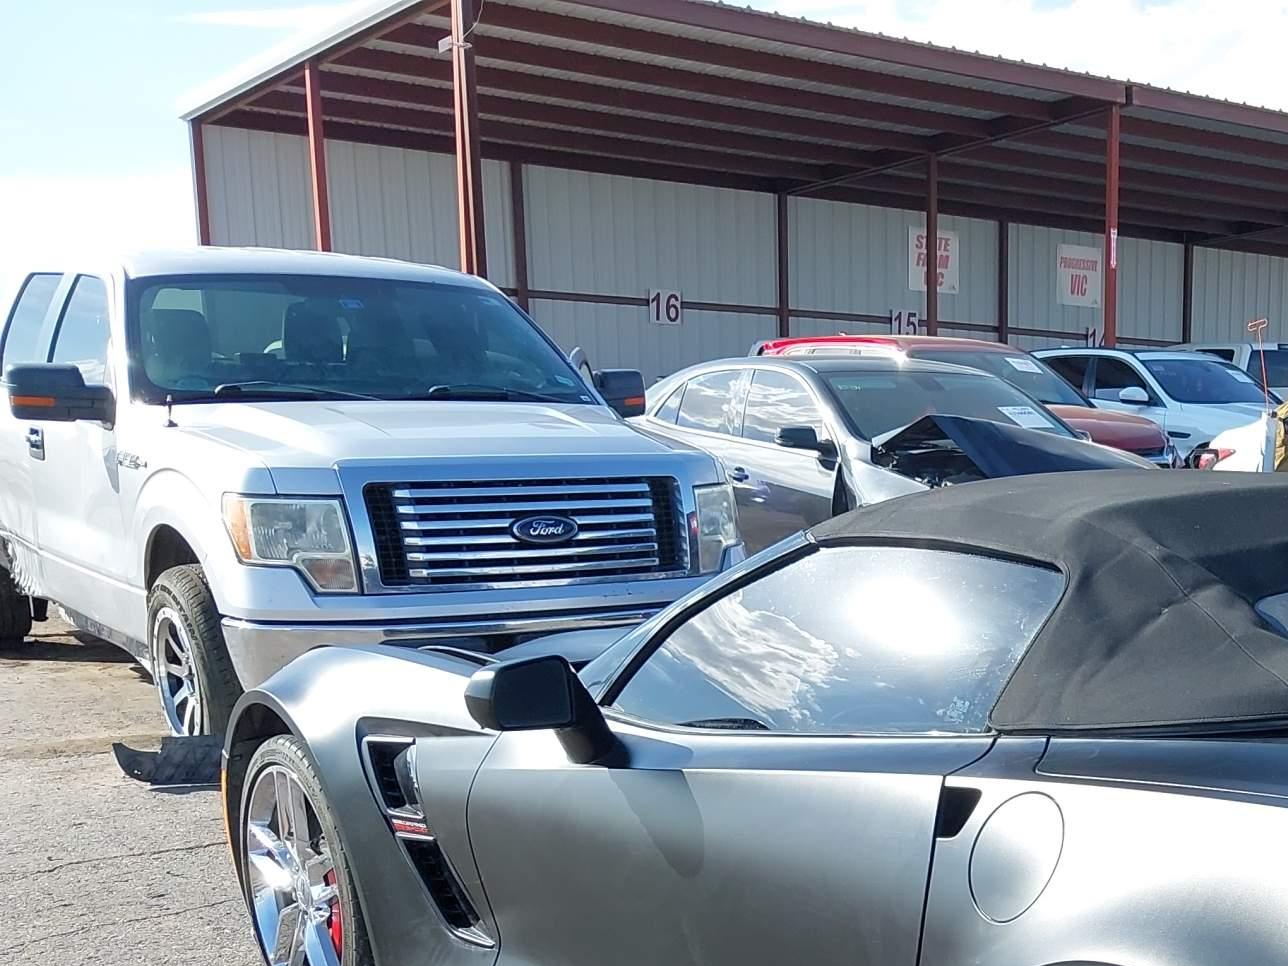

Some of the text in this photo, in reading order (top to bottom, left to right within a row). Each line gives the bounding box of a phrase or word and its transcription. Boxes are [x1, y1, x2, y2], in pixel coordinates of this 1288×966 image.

[1070, 274, 1088, 296] VIC
[651, 292, 679, 322] 16
[894, 311, 917, 335] 15
[529, 520, 565, 535] Ford
